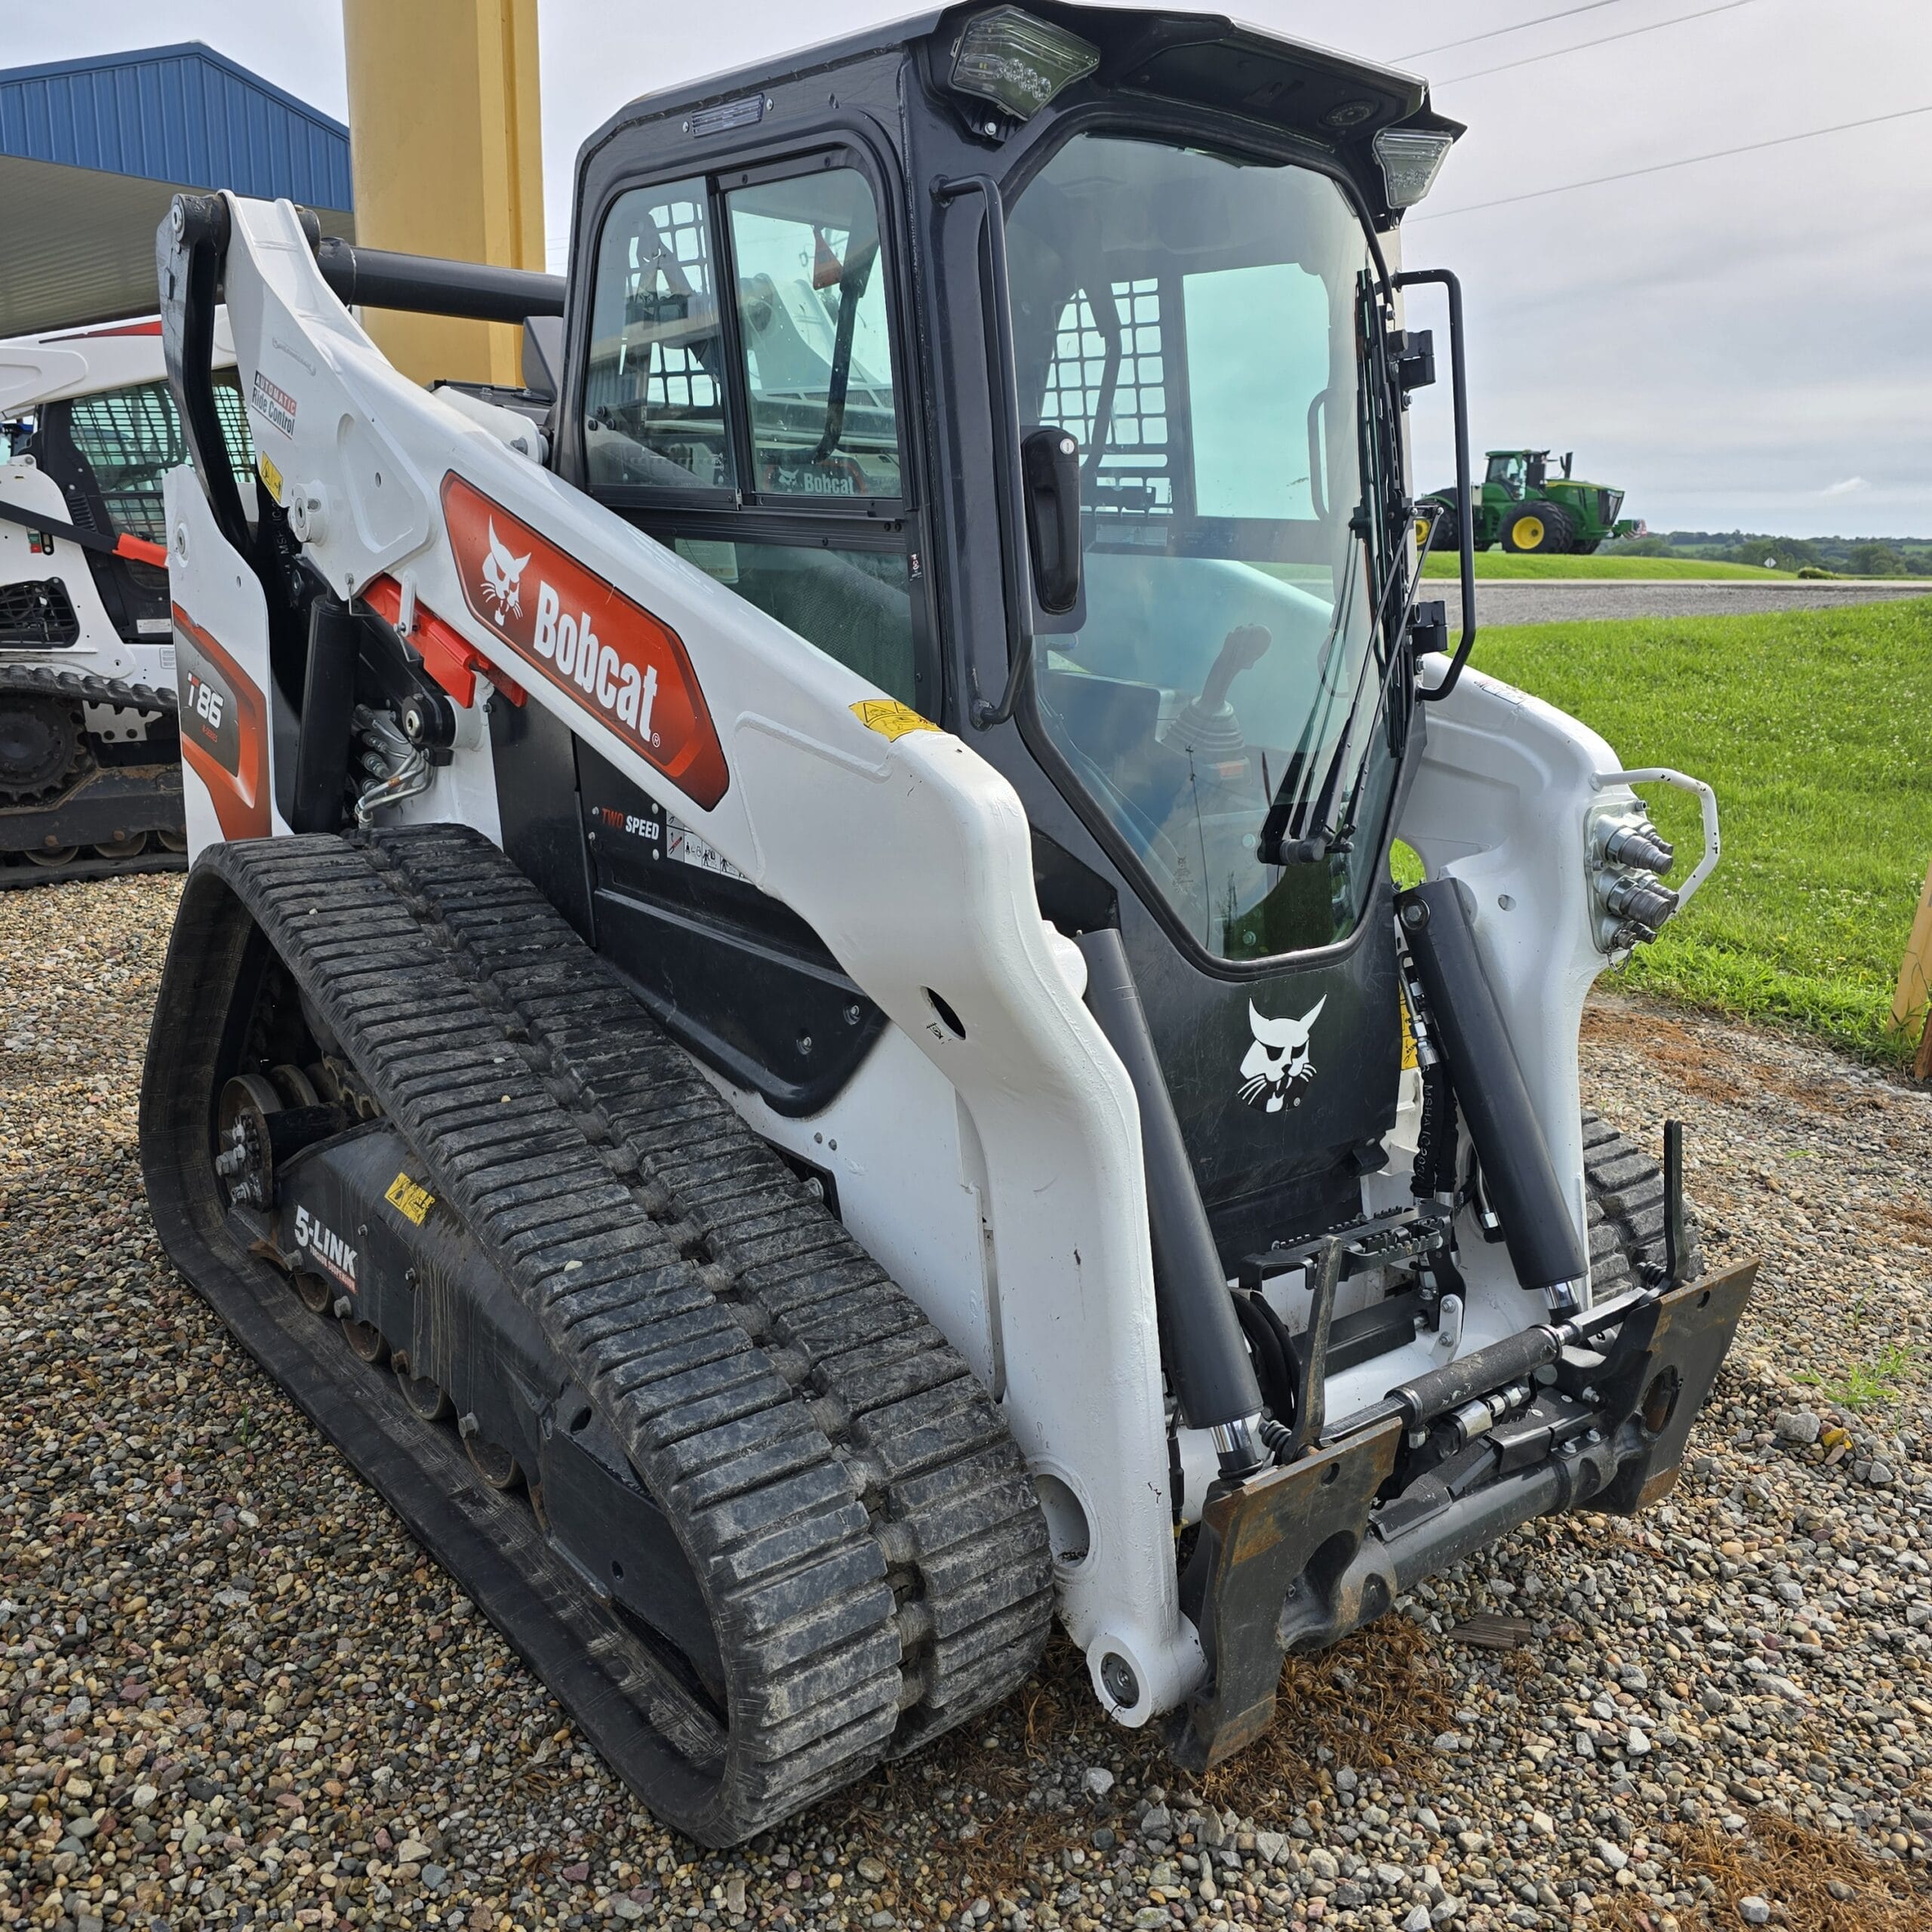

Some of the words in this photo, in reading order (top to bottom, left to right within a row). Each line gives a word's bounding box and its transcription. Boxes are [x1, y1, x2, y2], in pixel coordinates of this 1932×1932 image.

[252, 386, 268, 413] Ride
[268, 401, 295, 435] Control
[255, 372, 297, 415] AUTOMATIC
[803, 473, 855, 494] Bobcat
[533, 580, 658, 742] Bobcat
[187, 671, 224, 729] T86
[601, 808, 625, 829] TWO
[626, 815, 660, 840] SPEED
[294, 1204, 358, 1280] 5-LINK
